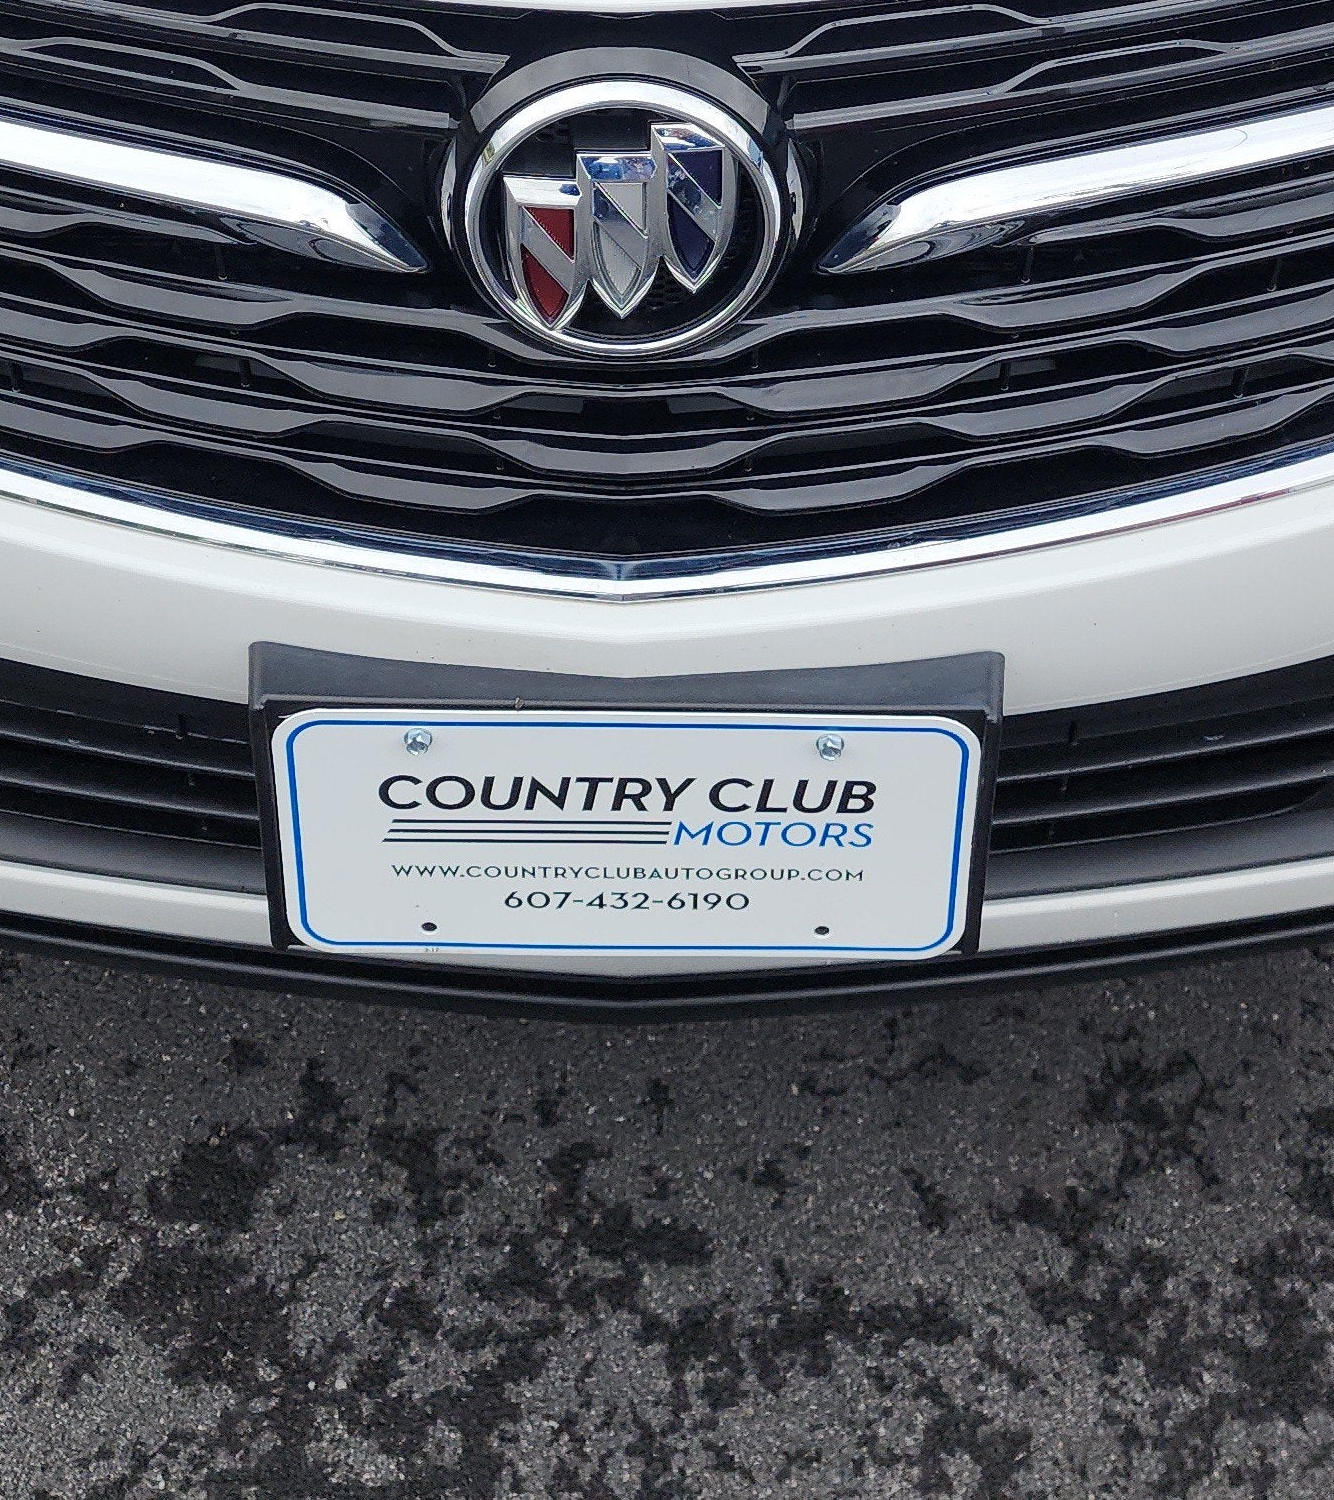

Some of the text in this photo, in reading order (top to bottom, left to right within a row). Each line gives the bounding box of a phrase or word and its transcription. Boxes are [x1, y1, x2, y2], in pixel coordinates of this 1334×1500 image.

[379, 775, 876, 814] COUNTRY CLUB
[674, 821, 874, 847] MOTORS
[391, 865, 863, 881] WWW.COUNTRYCLUBAUTOGROUP.COM
[505, 891, 749, 910] 607-432-6190
